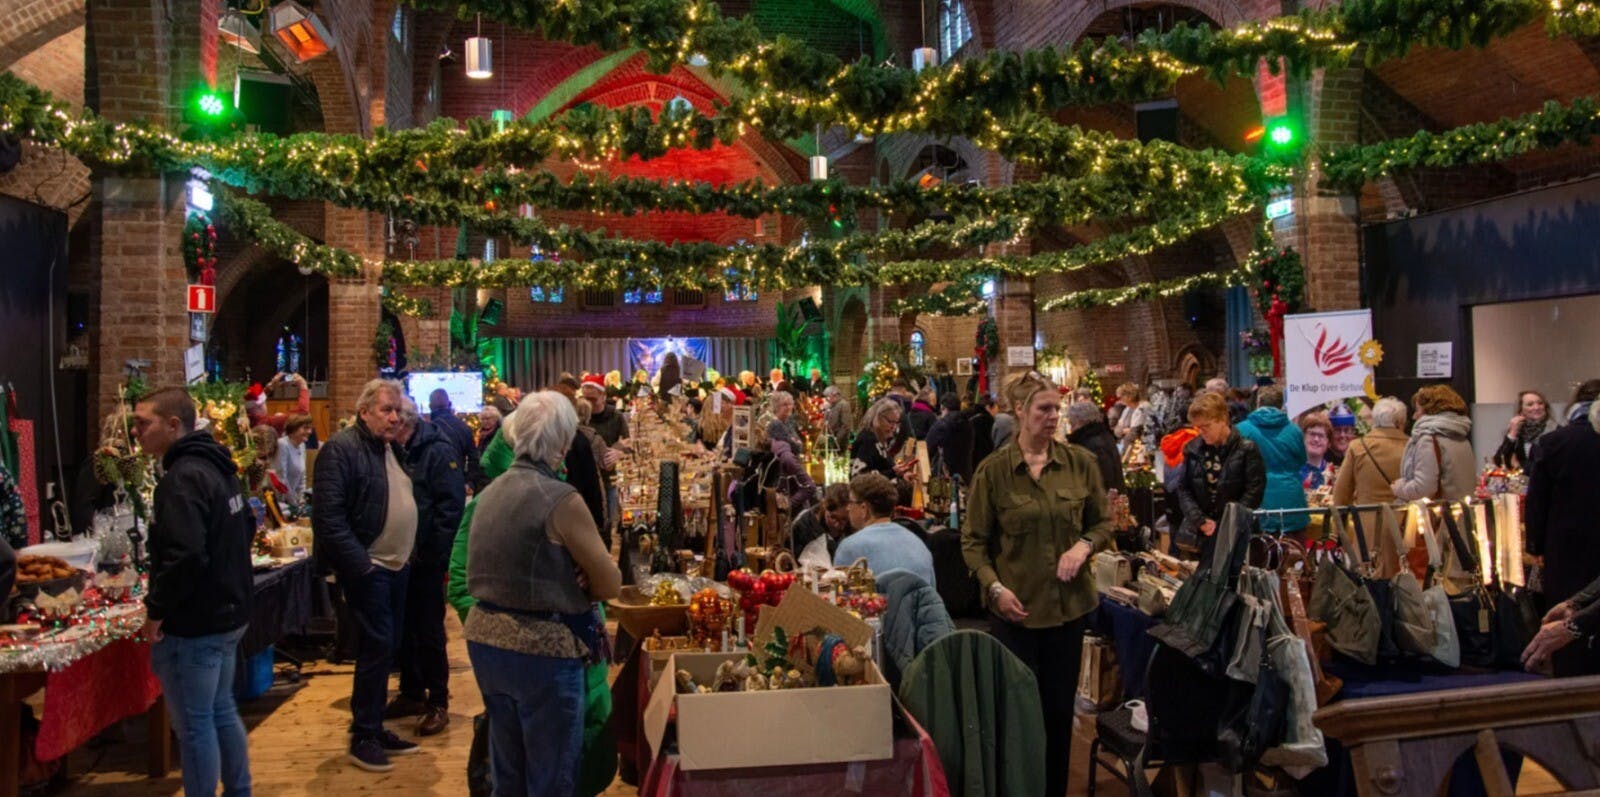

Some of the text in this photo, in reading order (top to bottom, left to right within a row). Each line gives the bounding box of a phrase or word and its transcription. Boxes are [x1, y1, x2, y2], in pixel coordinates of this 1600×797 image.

[1289, 382, 1364, 393] De Klup Over Betuw
